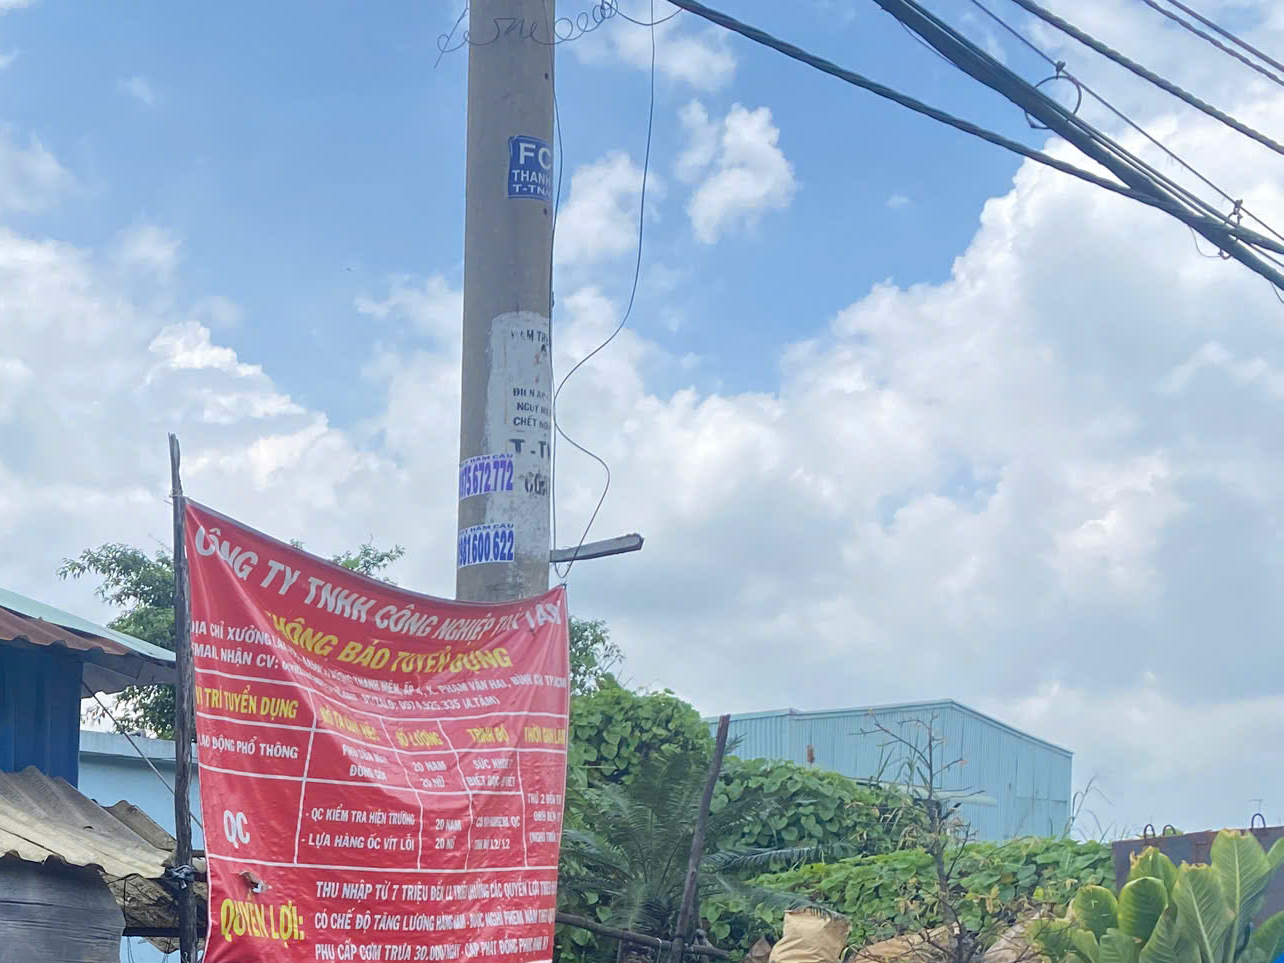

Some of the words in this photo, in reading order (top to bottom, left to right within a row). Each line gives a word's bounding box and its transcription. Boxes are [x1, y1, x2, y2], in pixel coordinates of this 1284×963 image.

[260, 560, 301, 595] TY
[304, 577, 376, 624] TNHH
[375, 604, 438, 637] CÔNG
[431, 612, 496, 645] NGHIỆP
[221, 648, 252, 667] NHẬN
[256, 654, 279, 669] CV:
[337, 639, 390, 669] BÁO
[204, 685, 223, 709] TRÍ
[223, 686, 257, 714] TUYỂN
[260, 697, 298, 720] DỤNG
[212, 734, 235, 752] ĐỘNG
[236, 736, 257, 755] PHỔ
[259, 742, 298, 759] THÔNG
[311, 808, 323, 821] QC
[326, 804, 348, 822] KIỂM
[351, 811, 367, 823] TRA
[435, 819, 444, 830] 20
[224, 810, 250, 848] QC
[308, 832, 331, 848] LỰA
[334, 833, 364, 849] HÀNG
[367, 833, 381, 849] ỐC
[383, 835, 398, 850] VÍT
[400, 834, 414, 850] LỖI
[435, 838, 444, 849] 20
[316, 882, 339, 898] THU
[341, 880, 372, 902] NHẬP
[376, 880, 391, 900] TỪ
[392, 885, 399, 900] 7
[402, 881, 428, 904] TRIỆU
[315, 909, 328, 929] CÓ
[330, 907, 355, 929] CHẾ
[356, 910, 371, 933] ĐỘ
[374, 912, 400, 930] TĂNG
[403, 913, 434, 931] LƯƠNG
[315, 944, 335, 963] PHỤ
[337, 938, 357, 960] CẤP
[359, 942, 382, 961] CƠM
[384, 942, 411, 960] TRƯA
